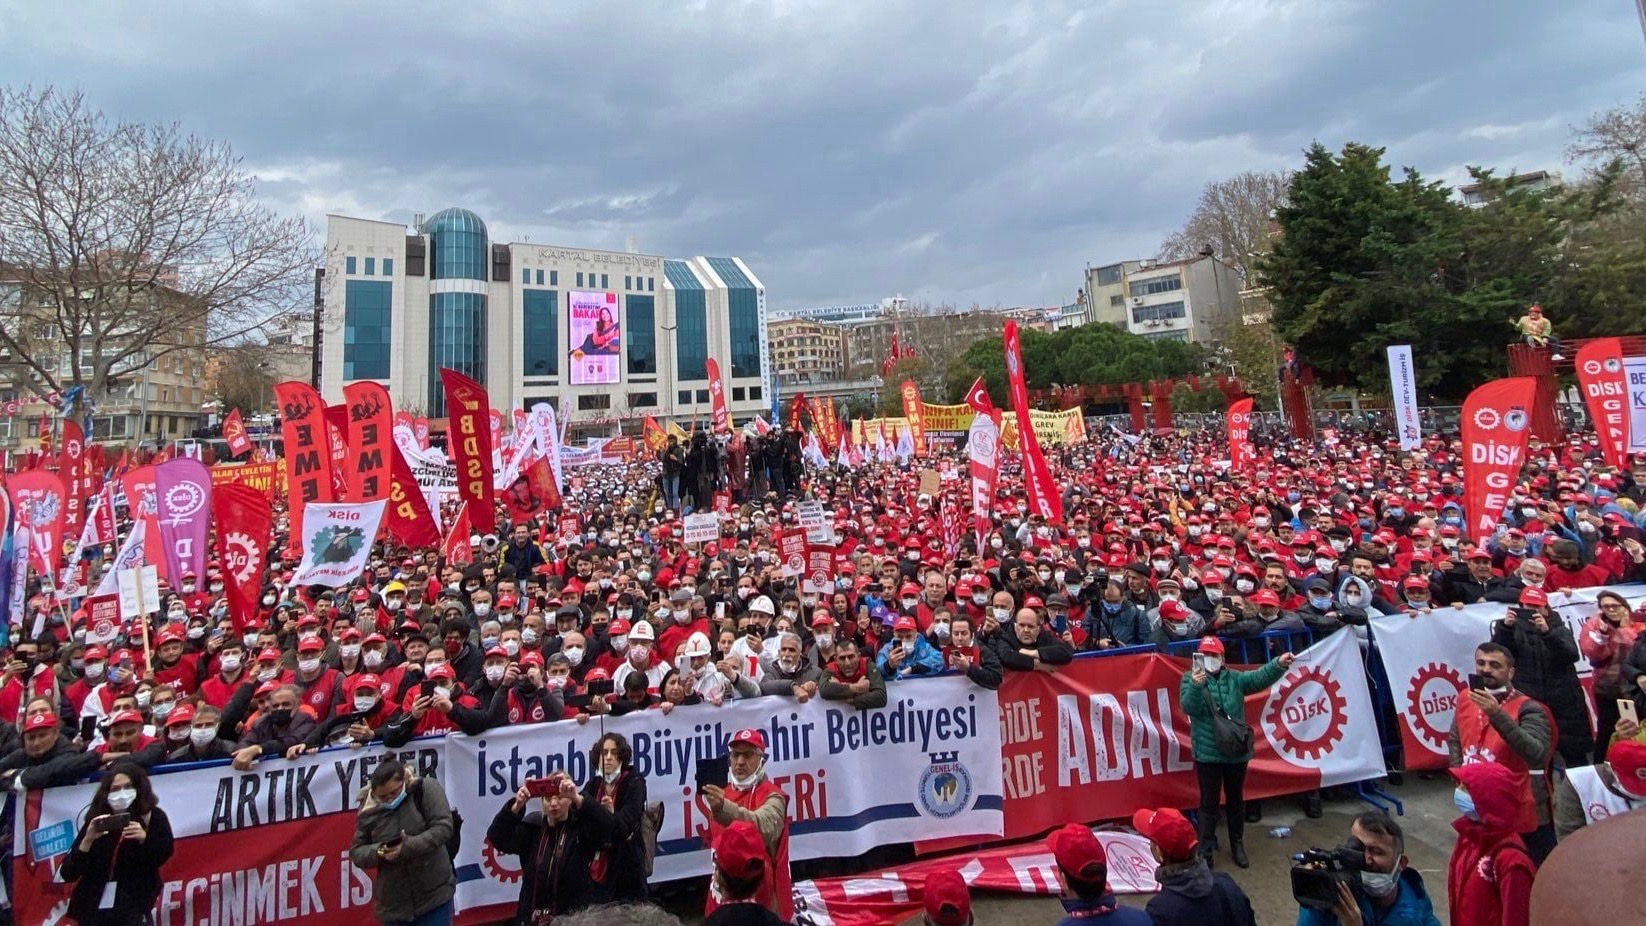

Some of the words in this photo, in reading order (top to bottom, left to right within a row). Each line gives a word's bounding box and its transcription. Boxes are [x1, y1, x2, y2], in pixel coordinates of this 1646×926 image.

[538, 249, 590, 262] KARTAL
[593, 251, 661, 268] BELEDİYESİ
[1630, 372, 1646, 385] BE
[1588, 380, 1624, 398] DİSK
[1633, 391, 1646, 406] K
[921, 405, 952, 416] INIFA
[1036, 431, 1060, 439] İRENİŞ
[1232, 428, 1248, 440] DİS
[1472, 439, 1521, 466] DİSK
[240, 465, 272, 476] EVLETİN
[637, 624, 647, 635] E
[692, 640, 700, 652] Y
[1285, 696, 1329, 725] DİSK
[1422, 691, 1457, 714] DİSK
[478, 740, 594, 797] İstanb
[632, 712, 815, 788] Büyükhir
[826, 694, 977, 753] Belediyesi
[1057, 688, 1198, 788] ADAL
[210, 764, 320, 833] ARTIK
[334, 748, 439, 811] YER
[151, 855, 326, 926] EÇİNMEK
